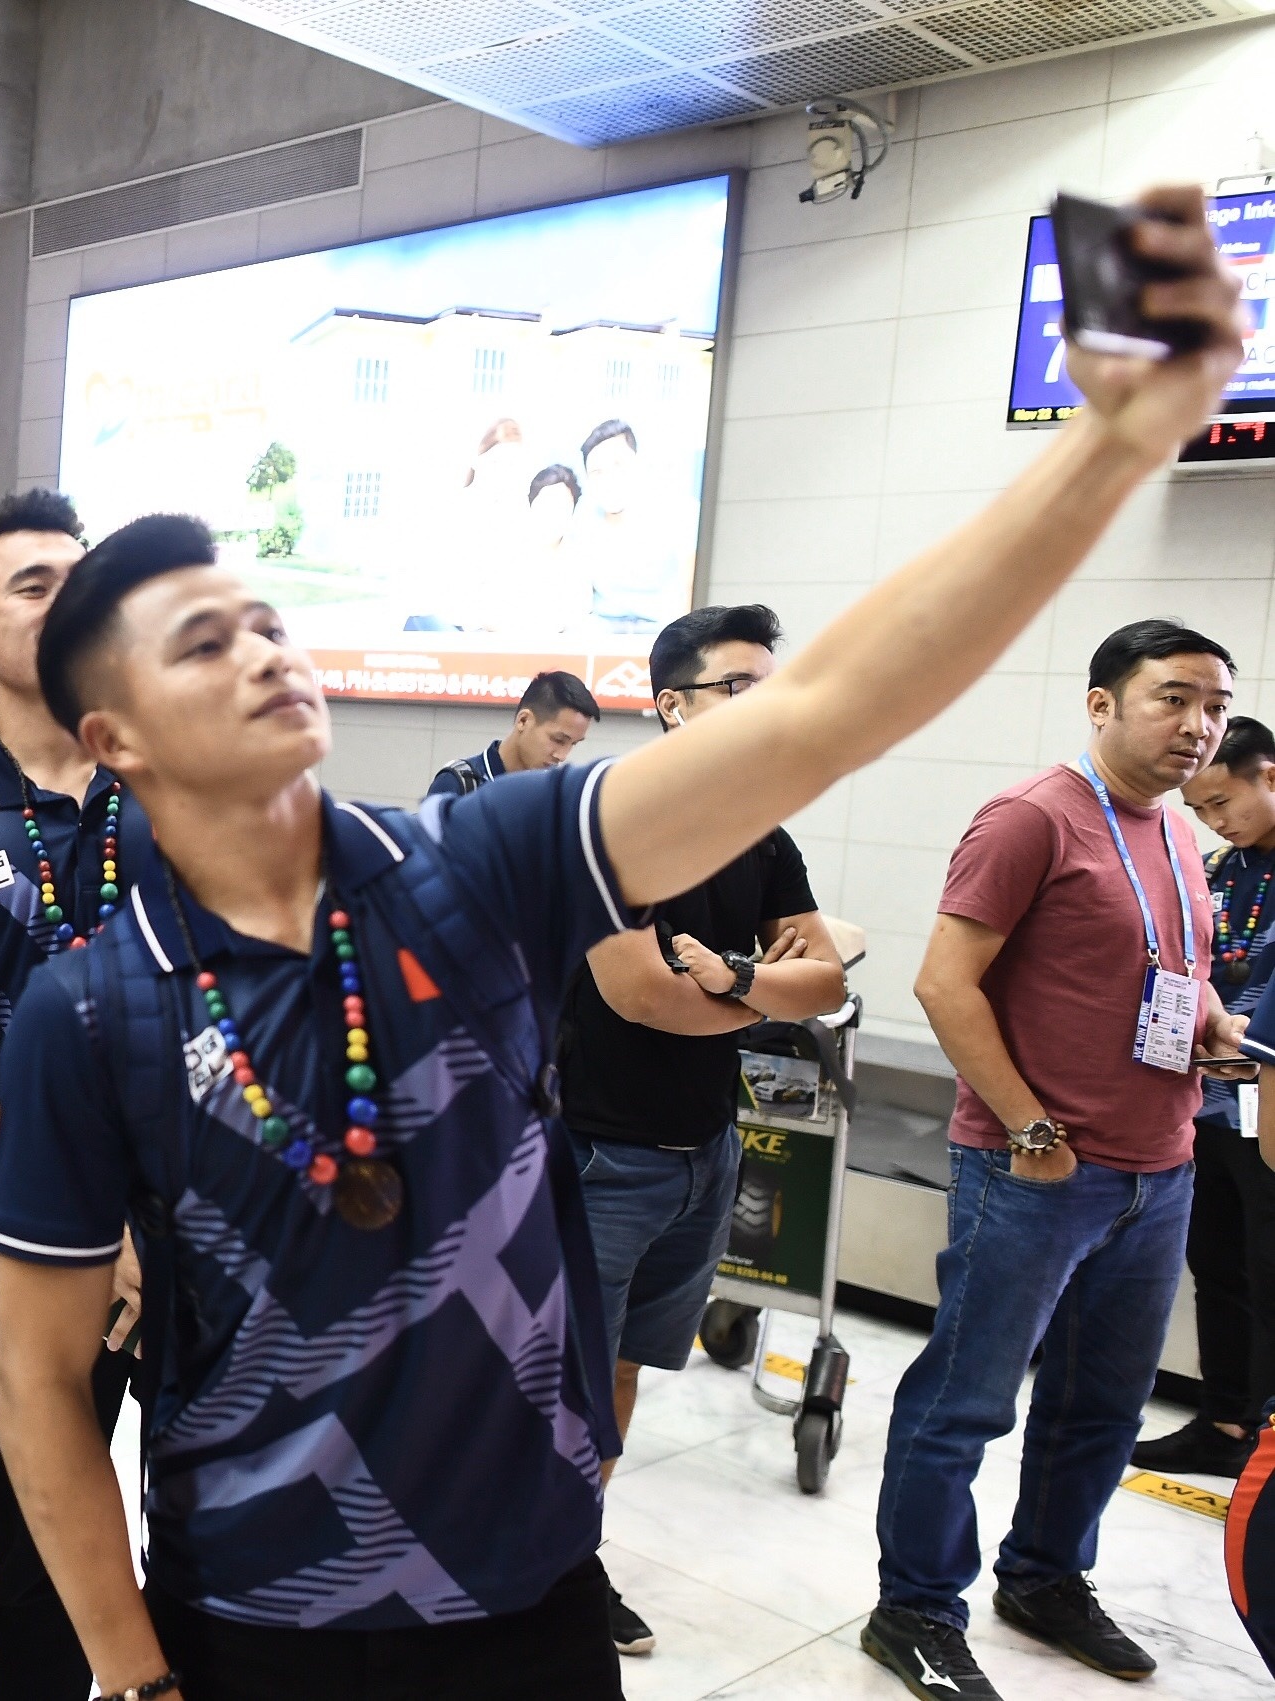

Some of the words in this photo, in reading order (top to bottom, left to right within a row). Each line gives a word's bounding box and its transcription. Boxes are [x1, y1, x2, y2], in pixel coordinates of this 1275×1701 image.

[1205, 206, 1240, 227] age
[1135, 1026, 1147, 1044] WIN
[1132, 1045, 1144, 1059] WE
[1162, 1483, 1230, 1511] WA
